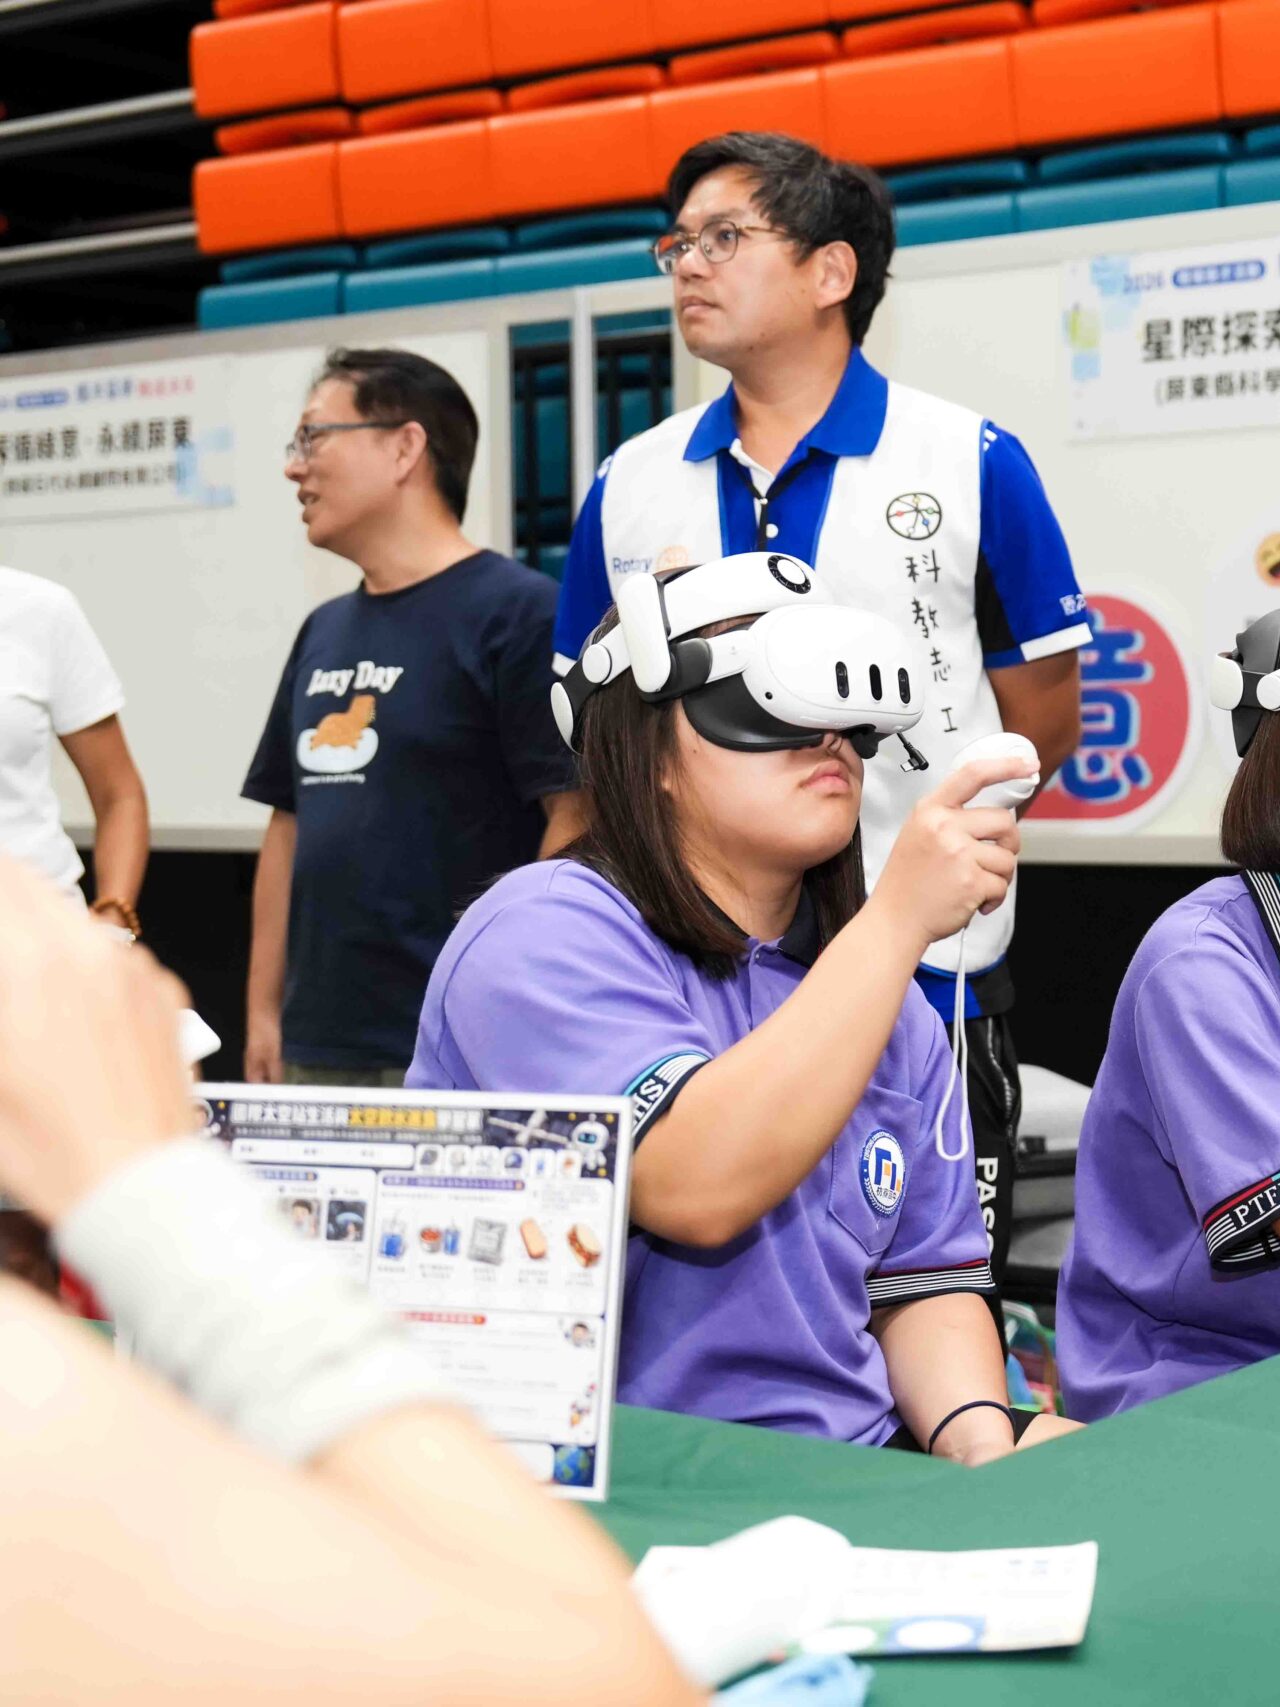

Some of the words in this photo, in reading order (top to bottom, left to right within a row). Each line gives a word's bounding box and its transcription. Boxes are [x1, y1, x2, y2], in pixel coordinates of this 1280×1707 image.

[353, 660, 404, 694] Day
[904, 549, 958, 733] 科教志工
